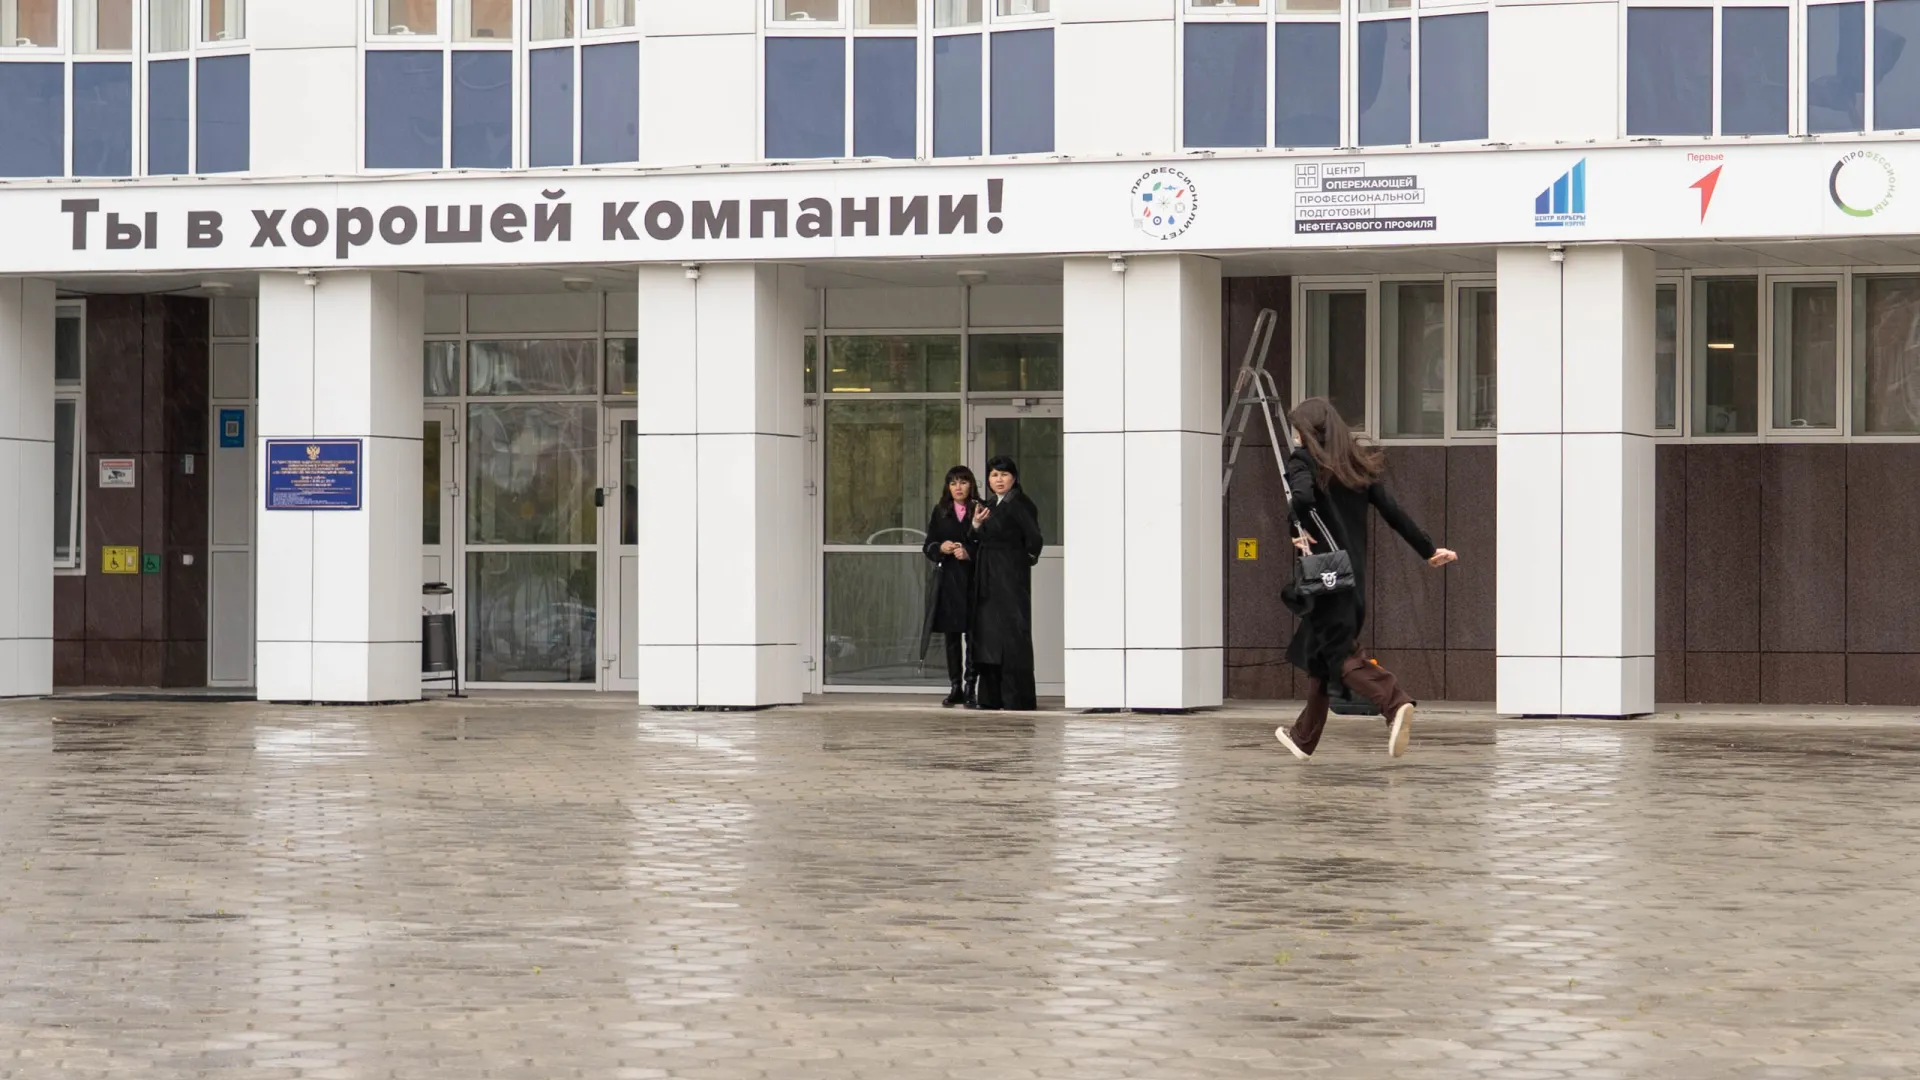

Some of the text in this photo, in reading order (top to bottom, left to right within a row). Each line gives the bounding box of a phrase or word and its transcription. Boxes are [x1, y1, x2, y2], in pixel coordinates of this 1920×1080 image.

[1687, 152, 1723, 164] Первые
[1326, 165, 1361, 175] ЦЕНТР
[1326, 177, 1413, 189] ОПЕРЕЖАЮЩЕЙ
[1131, 167, 1198, 240] ПРОФЕССИОНАЛИТЕТ
[1299, 191, 1420, 204] ПРОФЕССИОНАЛЬНОЙ
[62, 178, 1004, 259] Ты в хорошей компании!
[1299, 208, 1371, 218] ПОДГОТОВКИ
[1299, 220, 1434, 232] НЕФТЕГАЗОВОГО ПРОФИЛЯ
